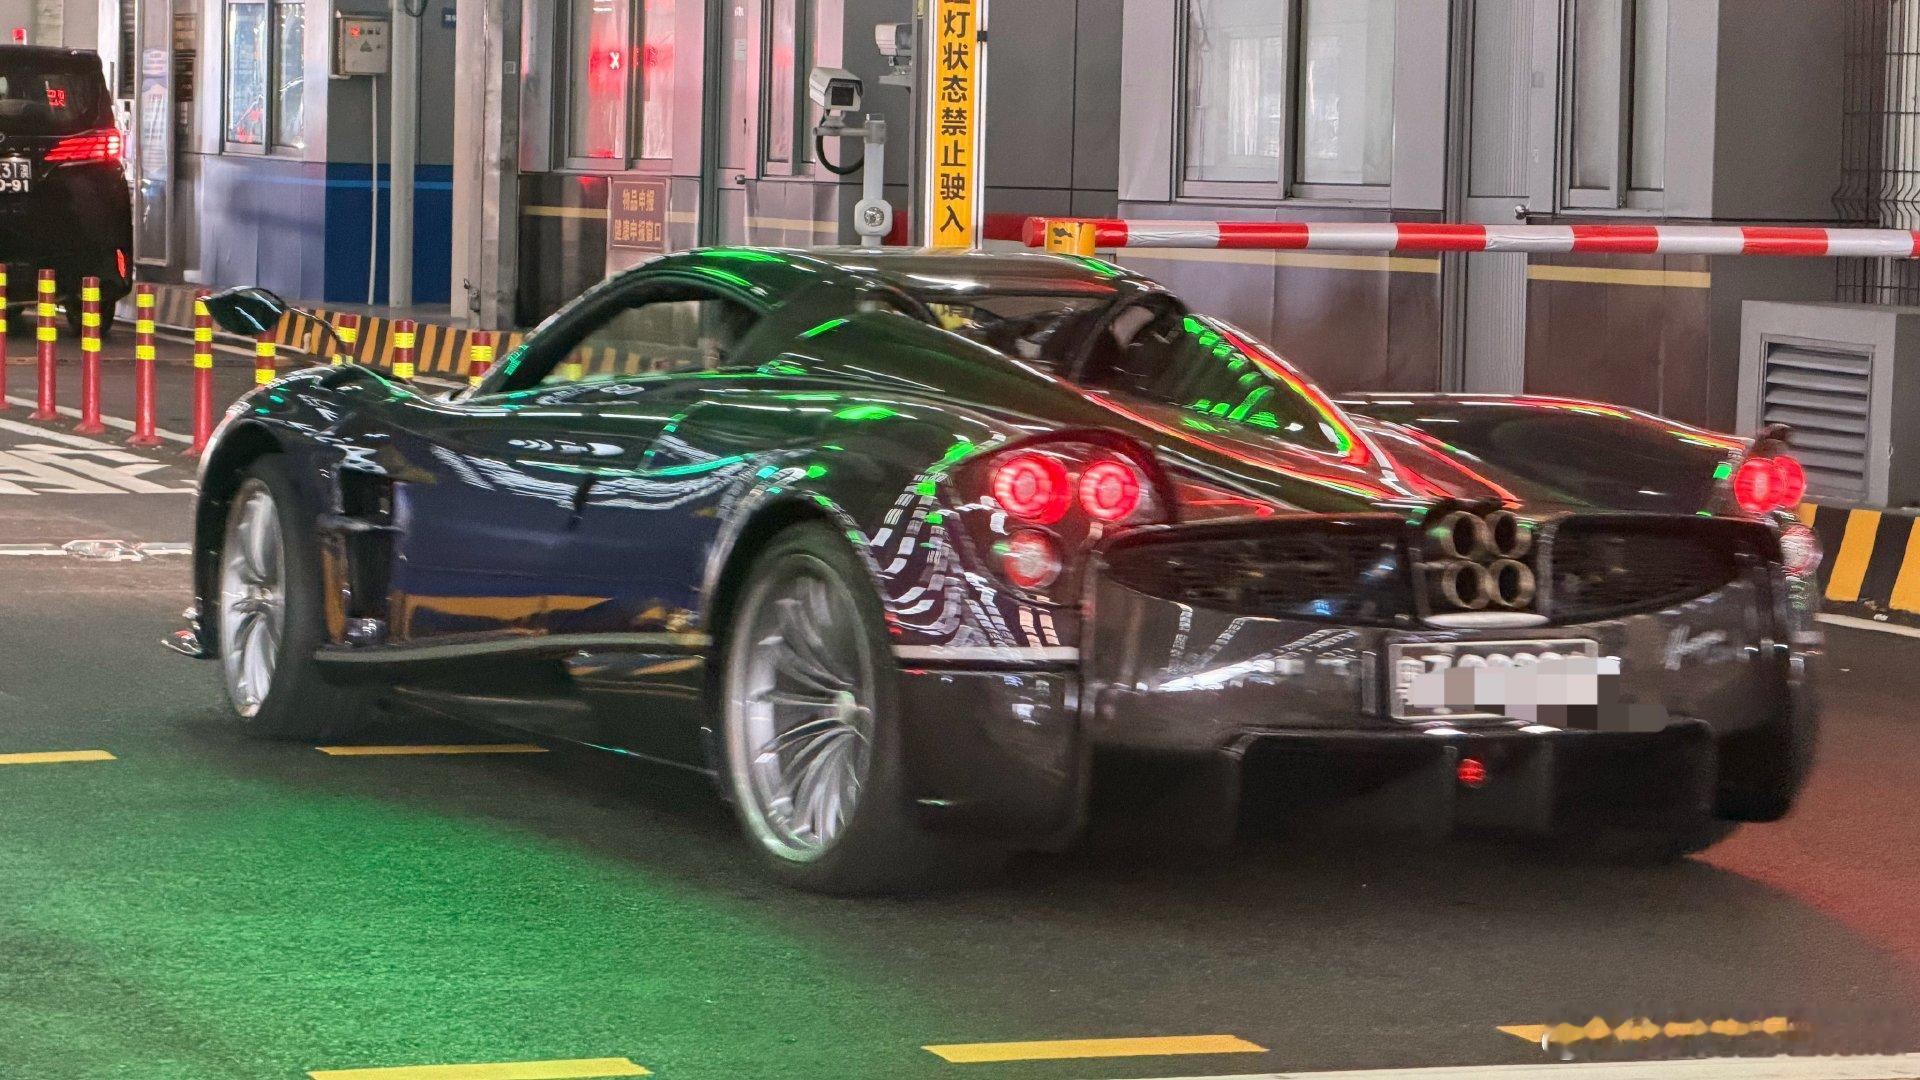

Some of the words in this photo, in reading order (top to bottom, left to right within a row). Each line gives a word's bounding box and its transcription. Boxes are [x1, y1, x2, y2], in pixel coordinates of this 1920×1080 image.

[939, 0, 971, 233] 灯状态禁止驶入
[623, 189, 655, 211] 物品申报
